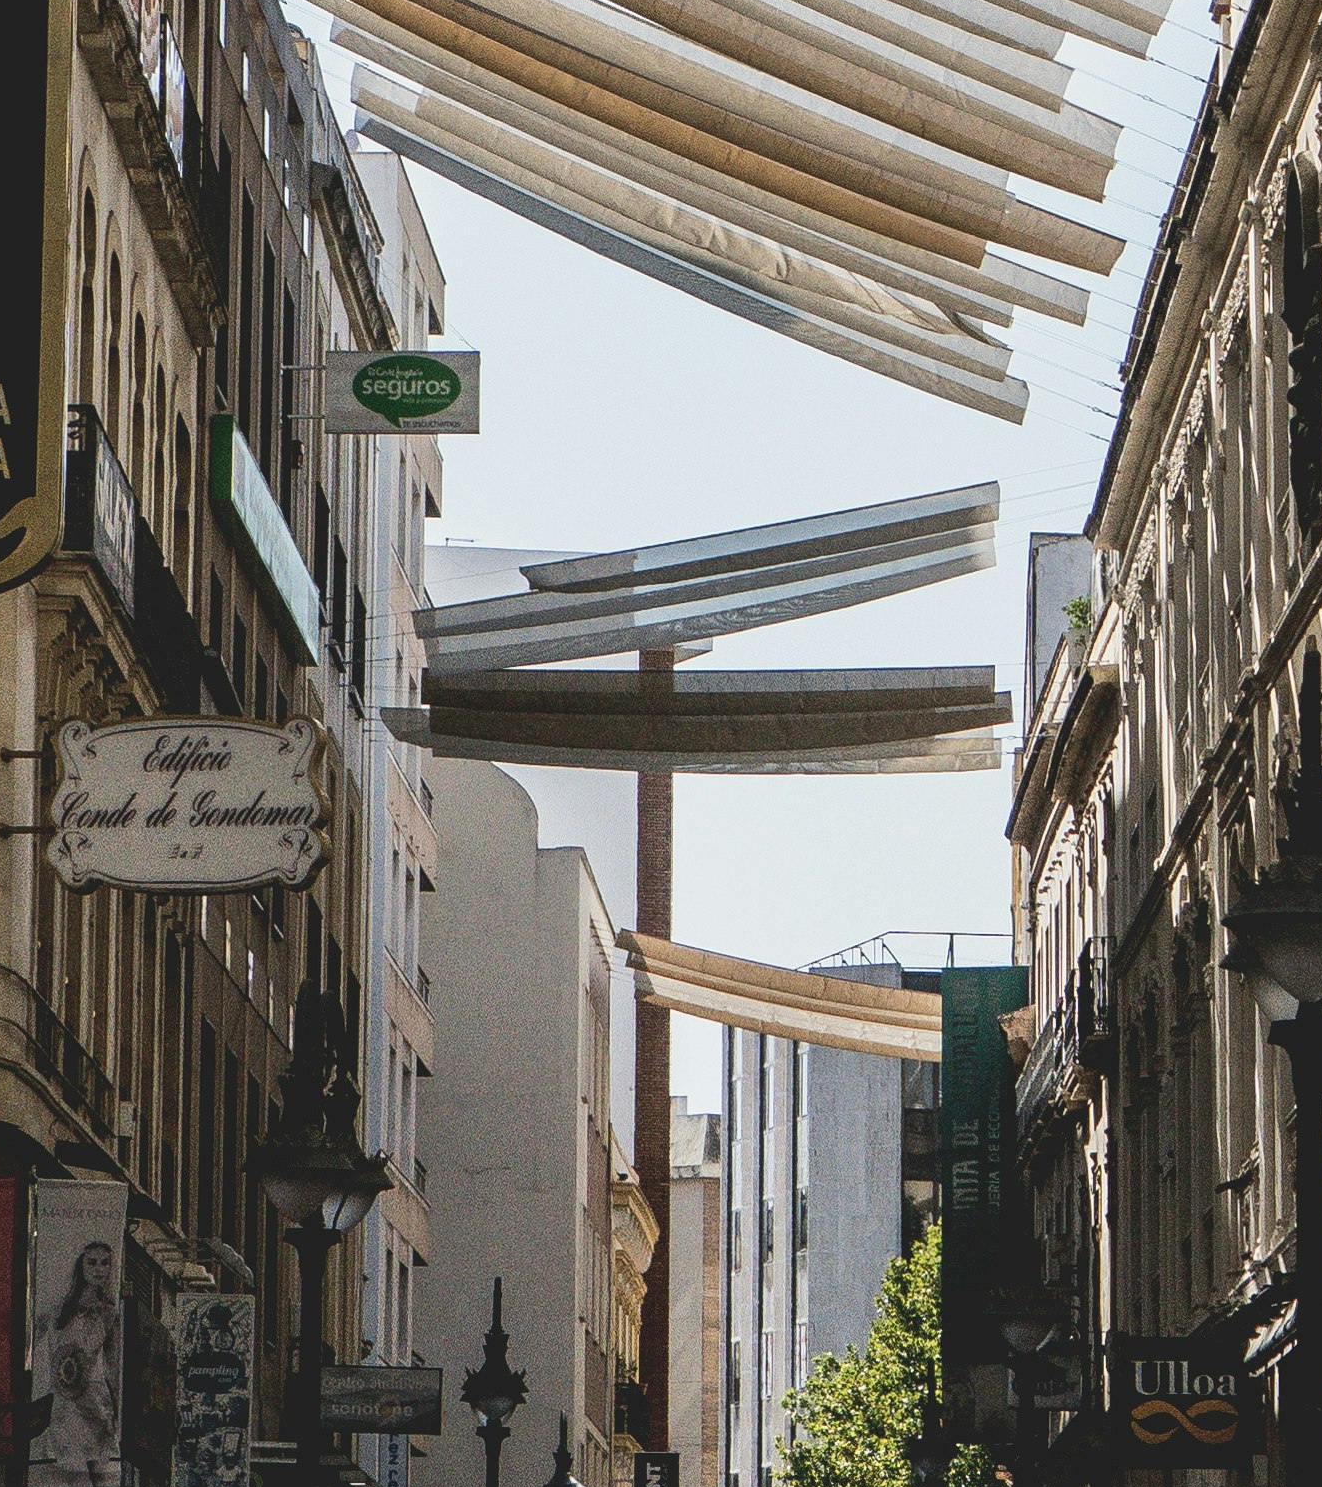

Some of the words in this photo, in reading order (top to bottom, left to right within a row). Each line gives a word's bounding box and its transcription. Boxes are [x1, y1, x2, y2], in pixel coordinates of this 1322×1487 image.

[361, 377, 452, 401] seguros
[142, 735, 233, 788] Edificio
[59, 791, 137, 828] Conde
[145, 791, 178, 828] de
[188, 789, 315, 828] Gondomar
[951, 1117, 979, 1146] DE
[187, 1364, 240, 1379] pampling
[1130, 1360, 1237, 1396] Ulloa
